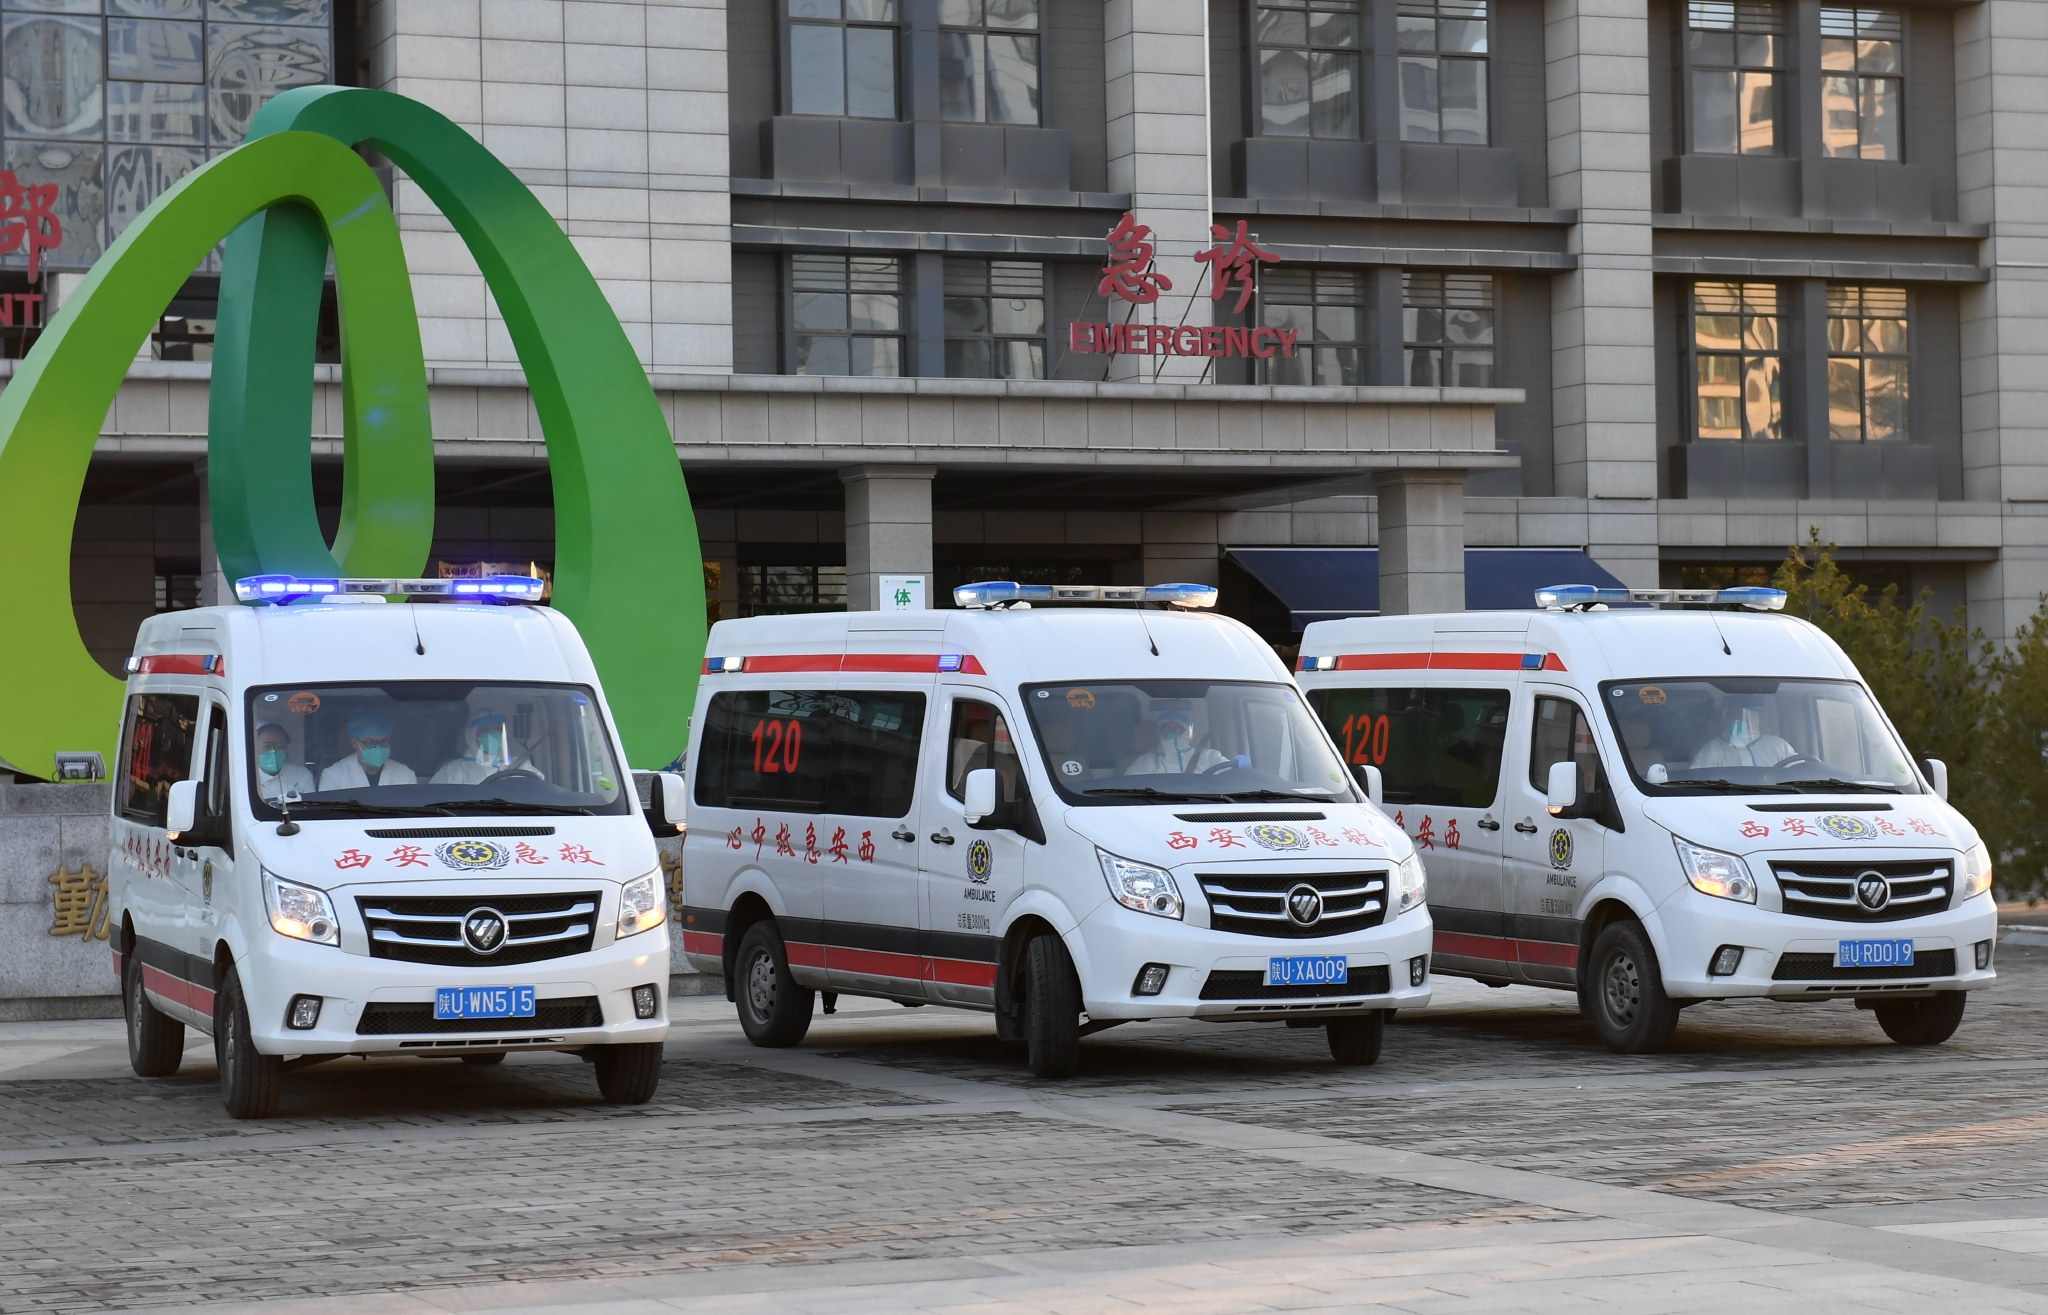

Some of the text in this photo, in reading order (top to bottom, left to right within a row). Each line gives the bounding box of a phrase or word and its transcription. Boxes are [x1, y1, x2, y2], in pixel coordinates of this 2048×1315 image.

[0, 170, 62, 284] 部
[1097, 212, 1281, 314] 急诊
[1070, 322, 1298, 358] EMERGENCY
[894, 588, 911, 606] 体
[751, 719, 801, 773] 120
[1342, 714, 1390, 765] 120
[1064, 763, 1080, 774] 13
[1166, 827, 1247, 850] 西安
[1306, 825, 1383, 848] 急救
[1738, 817, 1819, 838] 西安
[1874, 816, 1947, 837] 急救
[334, 844, 432, 869] 西安
[515, 841, 605, 867] 急救
[1546, 873, 1577, 888] AMBULANCE
[963, 887, 996, 903] AMBULANCE
